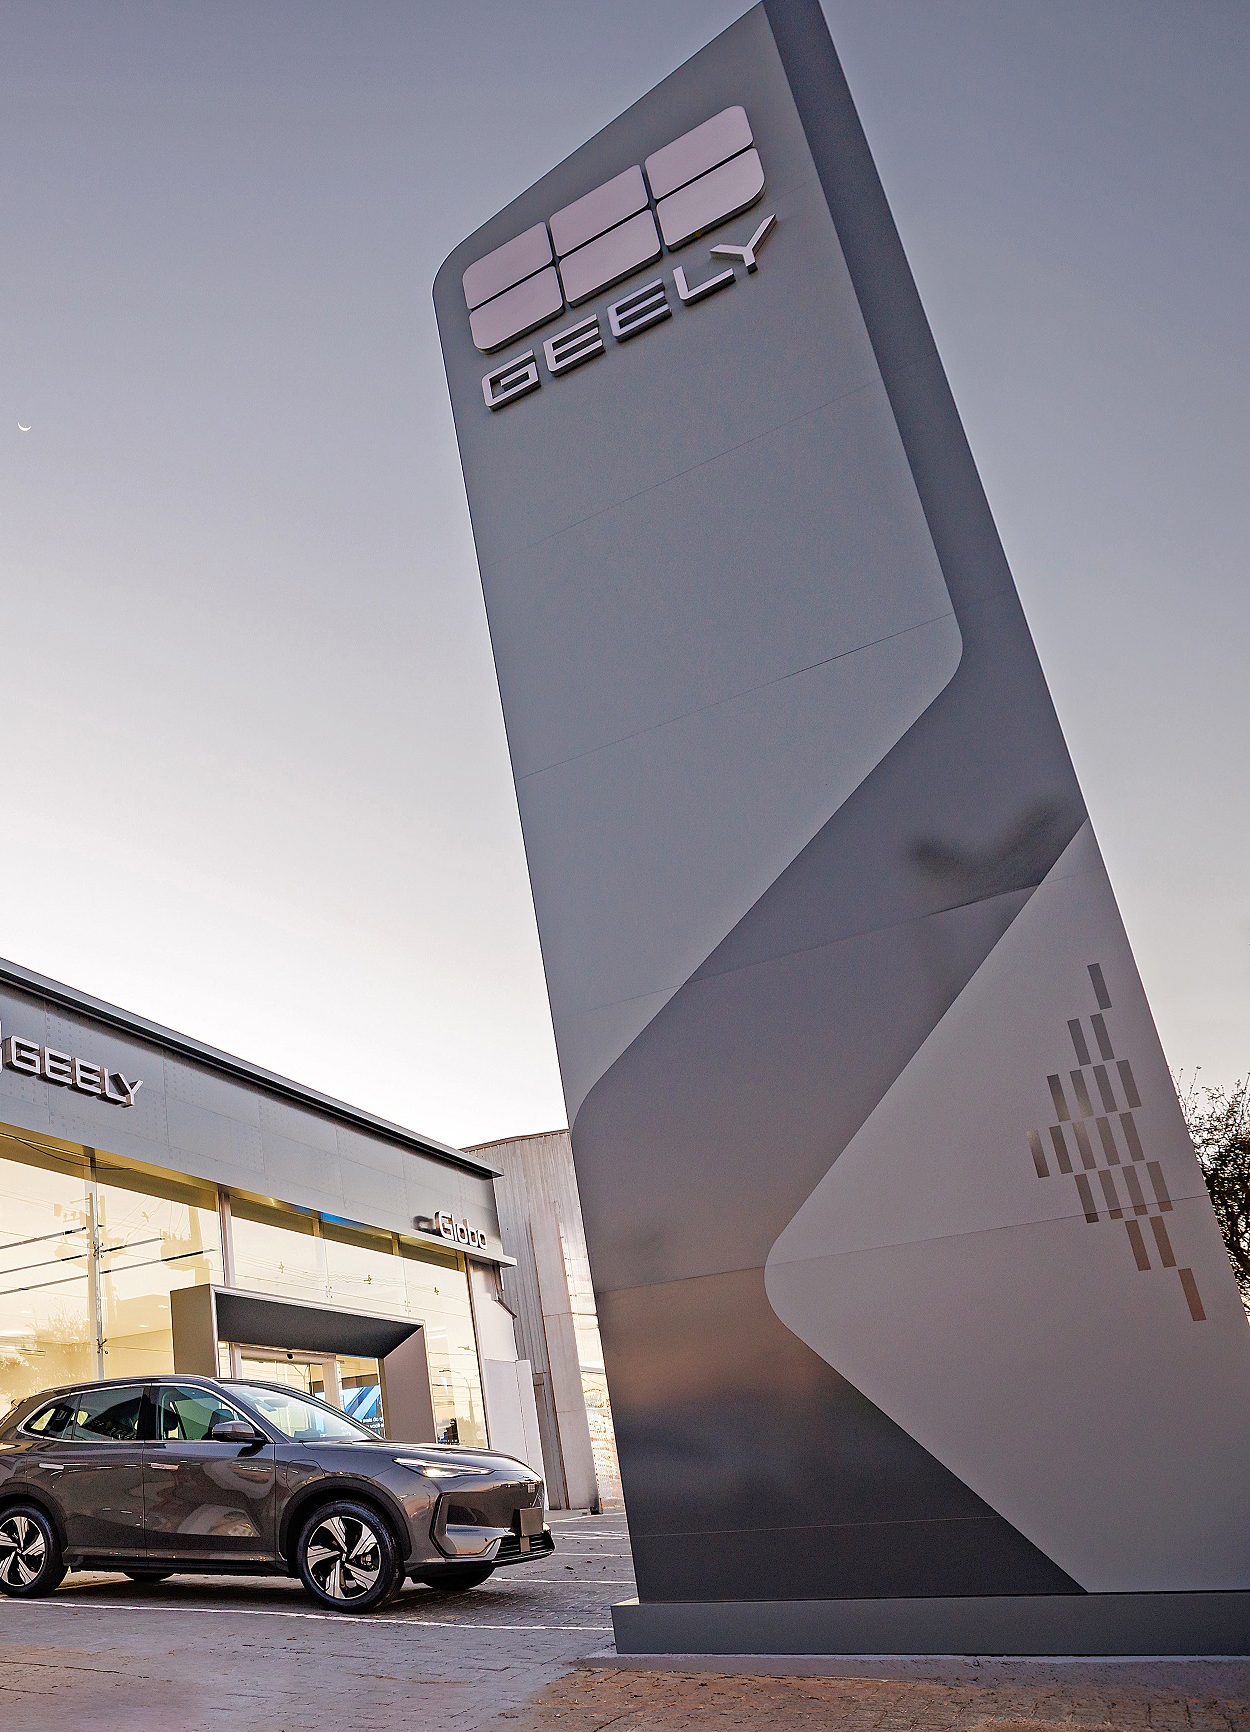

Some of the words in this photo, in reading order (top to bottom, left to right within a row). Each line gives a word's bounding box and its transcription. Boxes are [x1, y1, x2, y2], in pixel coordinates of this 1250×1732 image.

[481, 213, 777, 411] GEELY
[7, 1035, 144, 1107] GEELY
[436, 1210, 488, 1250] Globo
